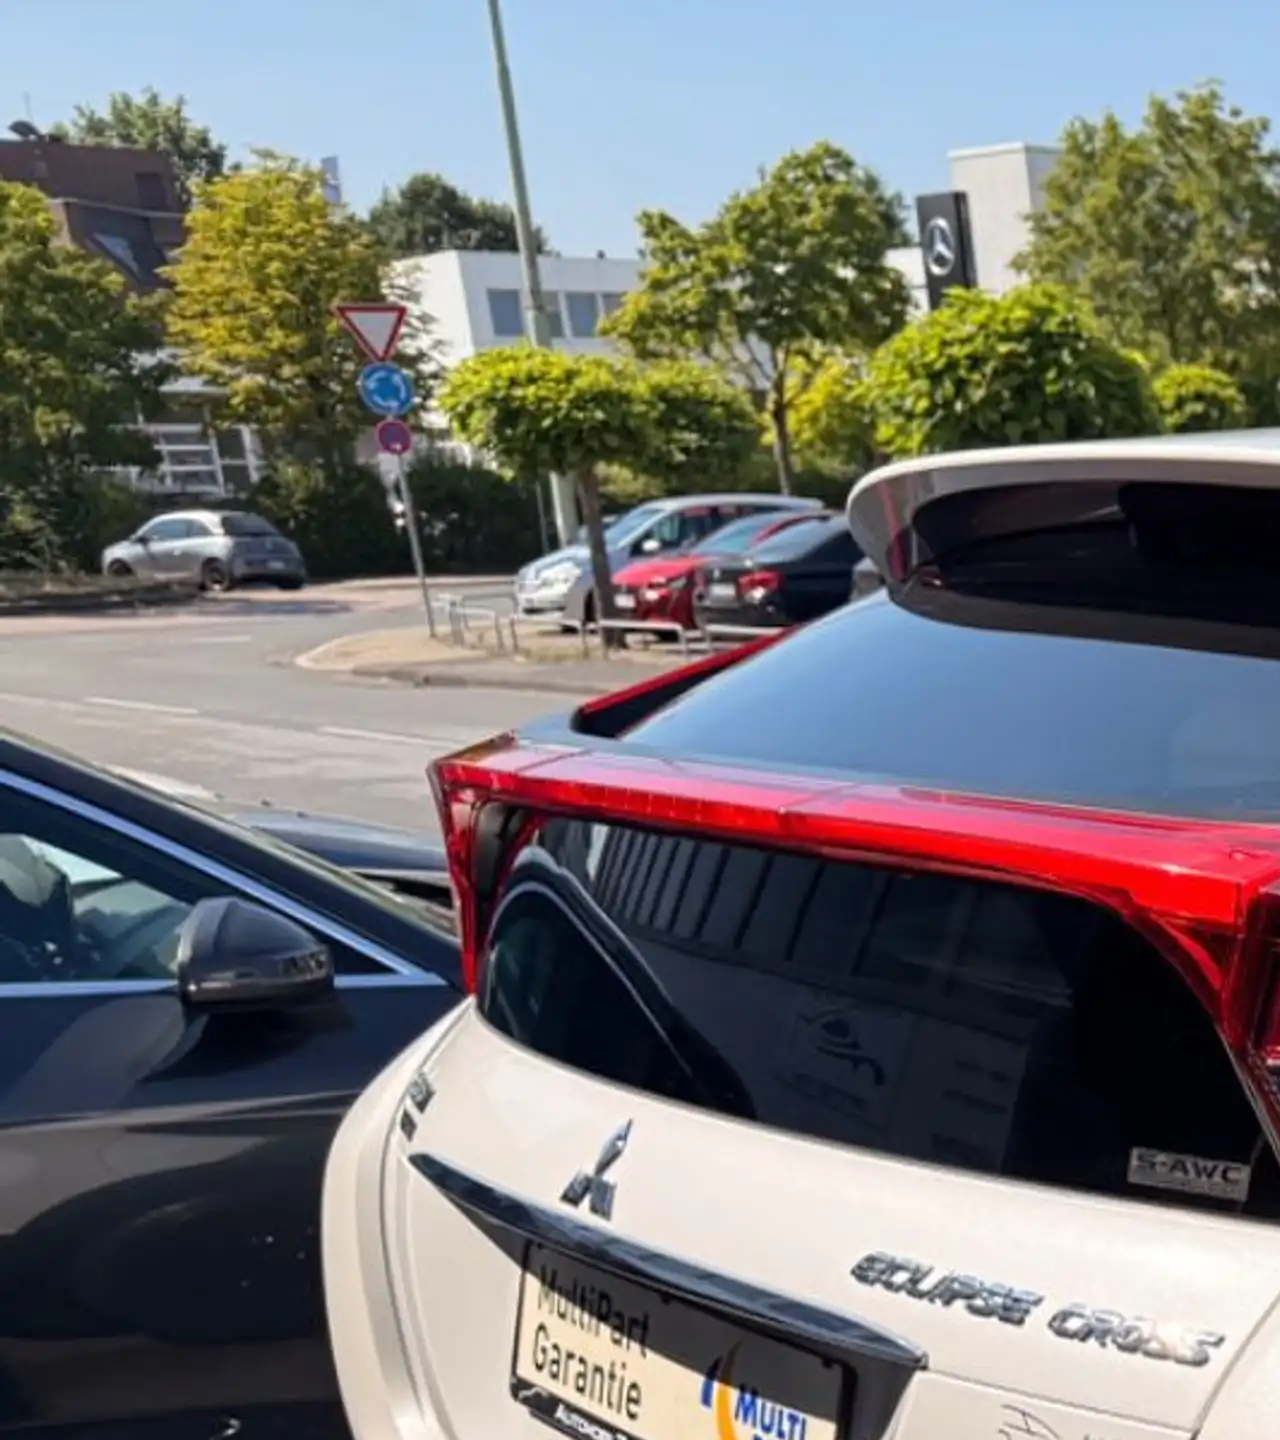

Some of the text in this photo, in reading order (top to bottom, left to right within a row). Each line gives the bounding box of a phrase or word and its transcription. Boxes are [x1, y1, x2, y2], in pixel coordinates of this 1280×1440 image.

[537, 1264, 650, 1360] MultiPart
[850, 1250, 1226, 1367] ECLIPSE CROSS
[531, 1322, 643, 1422] Garantie
